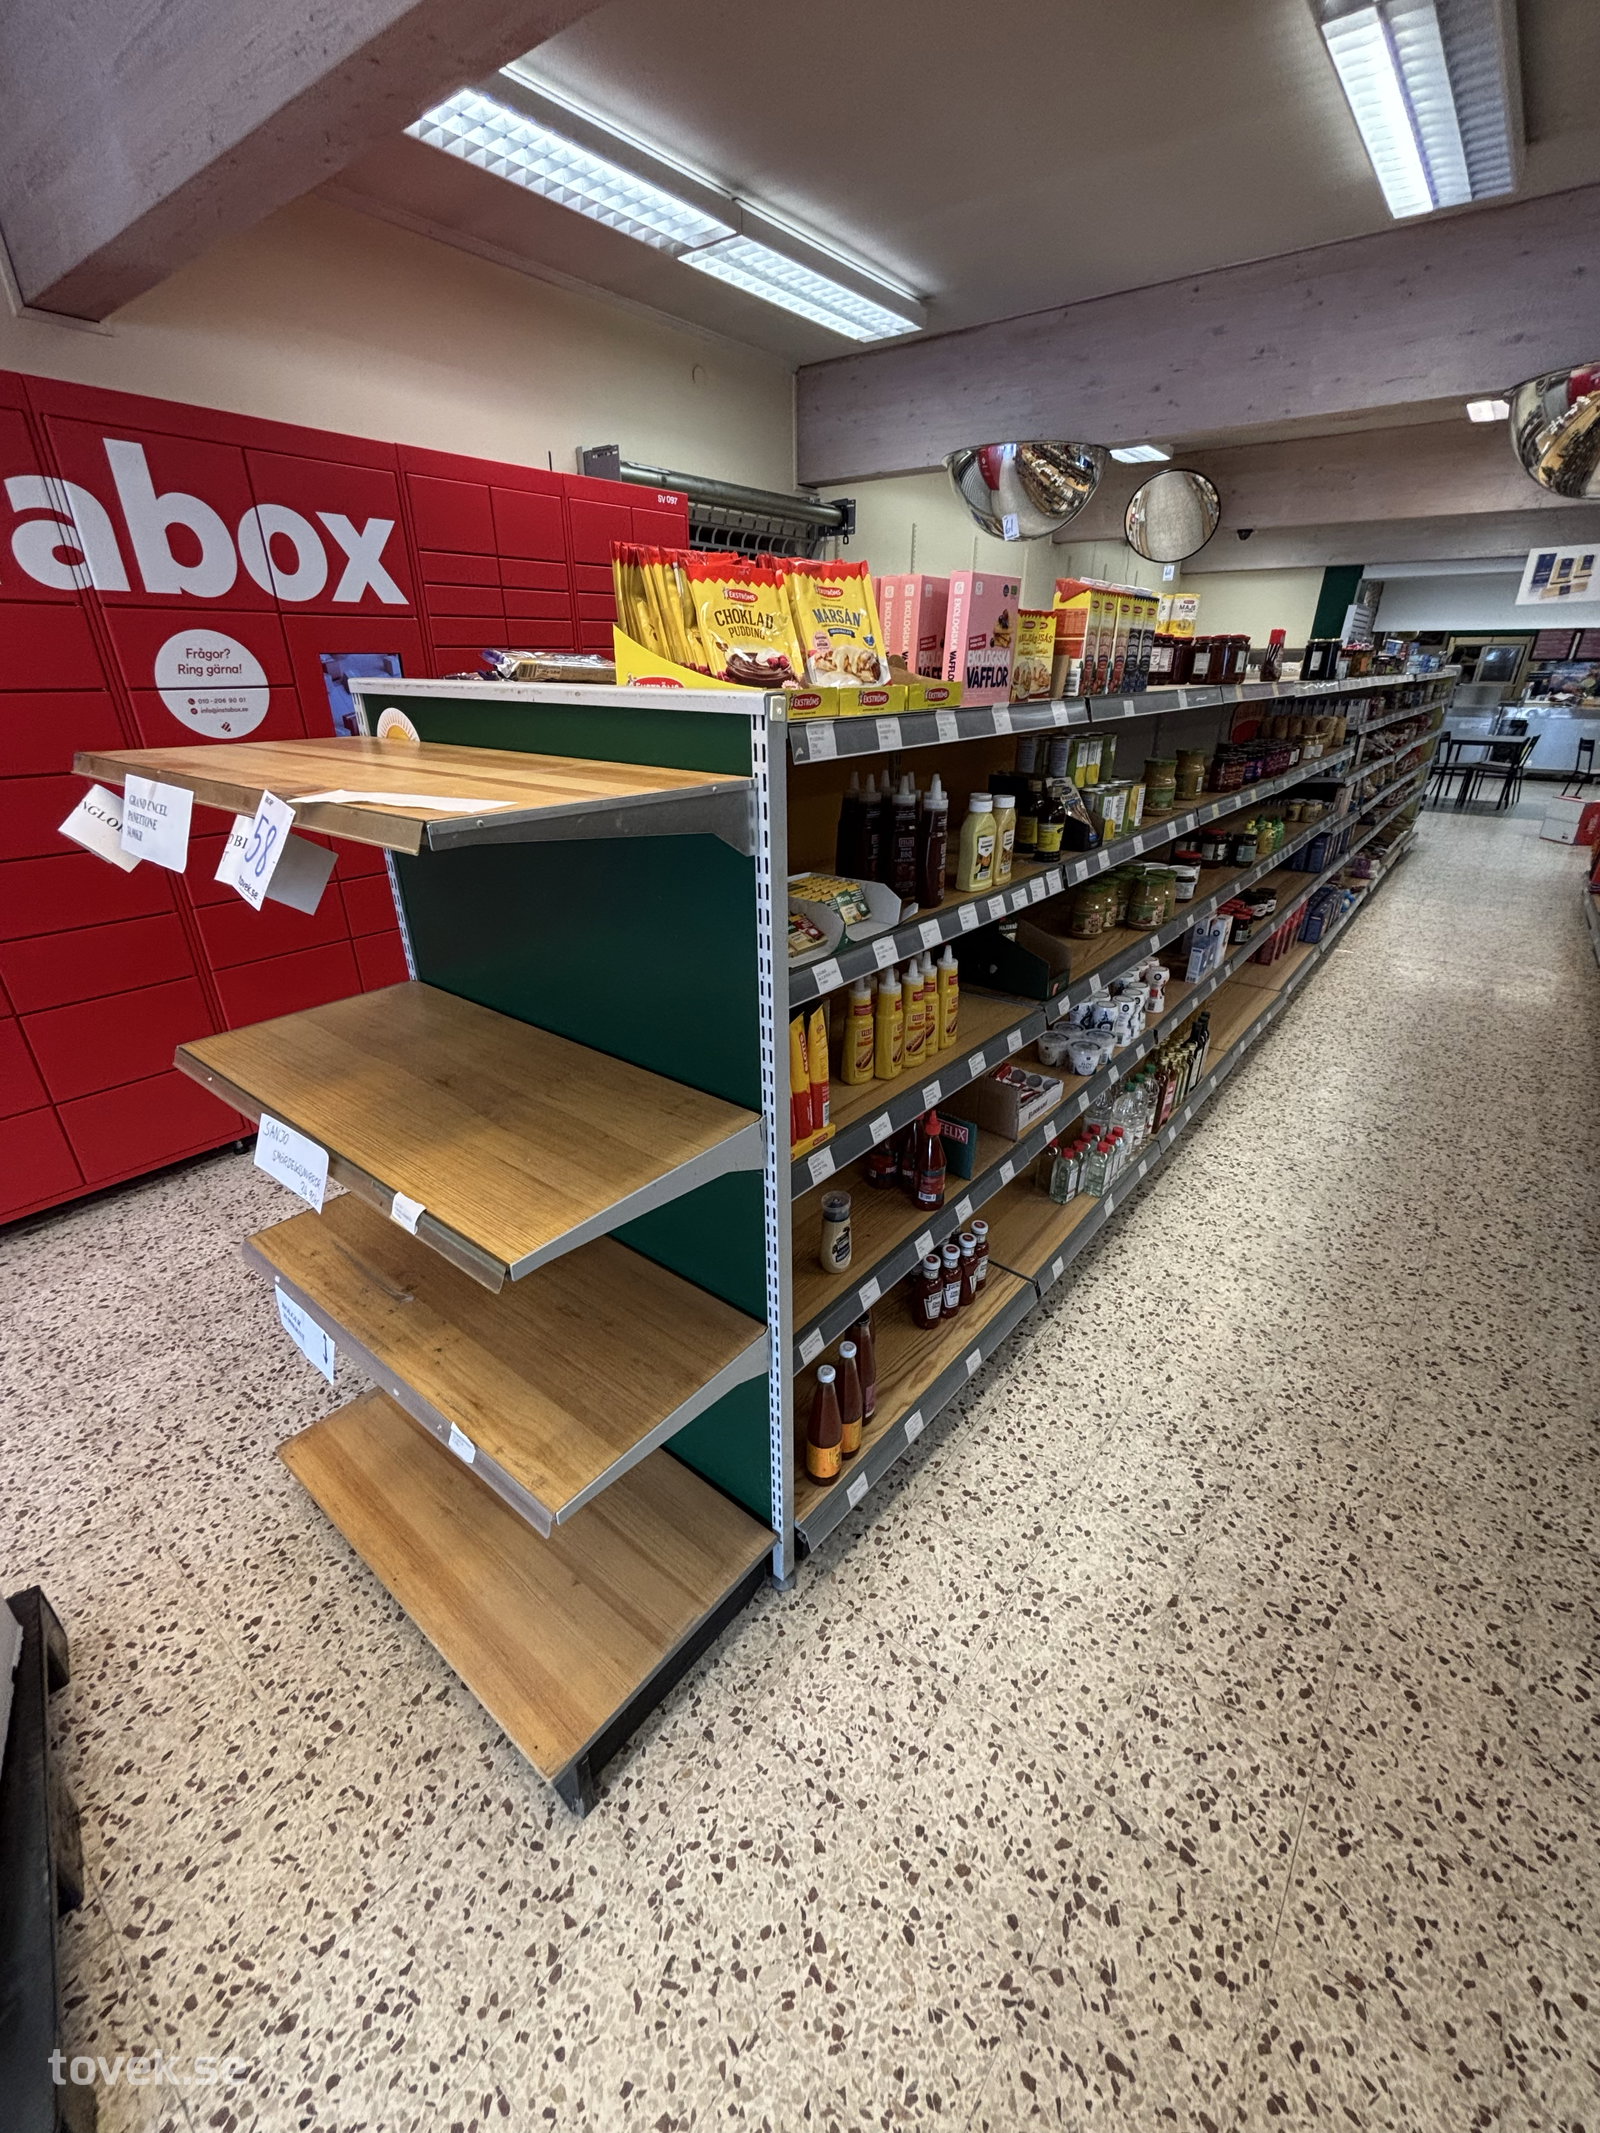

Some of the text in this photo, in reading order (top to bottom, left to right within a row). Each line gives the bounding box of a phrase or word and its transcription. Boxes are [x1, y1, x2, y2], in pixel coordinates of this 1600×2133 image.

[714, 608, 774, 629] CHOKLAD
[728, 626, 765, 640] PUDDING
[185, 648, 231, 661] Frågor?
[967, 650, 1010, 666] EKOLOGISKA
[177, 664, 242, 677] Ring gärna!
[967, 667, 1009, 688] VÅFFLOR
[128, 810, 158, 830] PANETTONE
[244, 814, 277, 877] 58
[237, 875, 259, 901] tovek.se
[940, 1122, 966, 1141] FELIX
